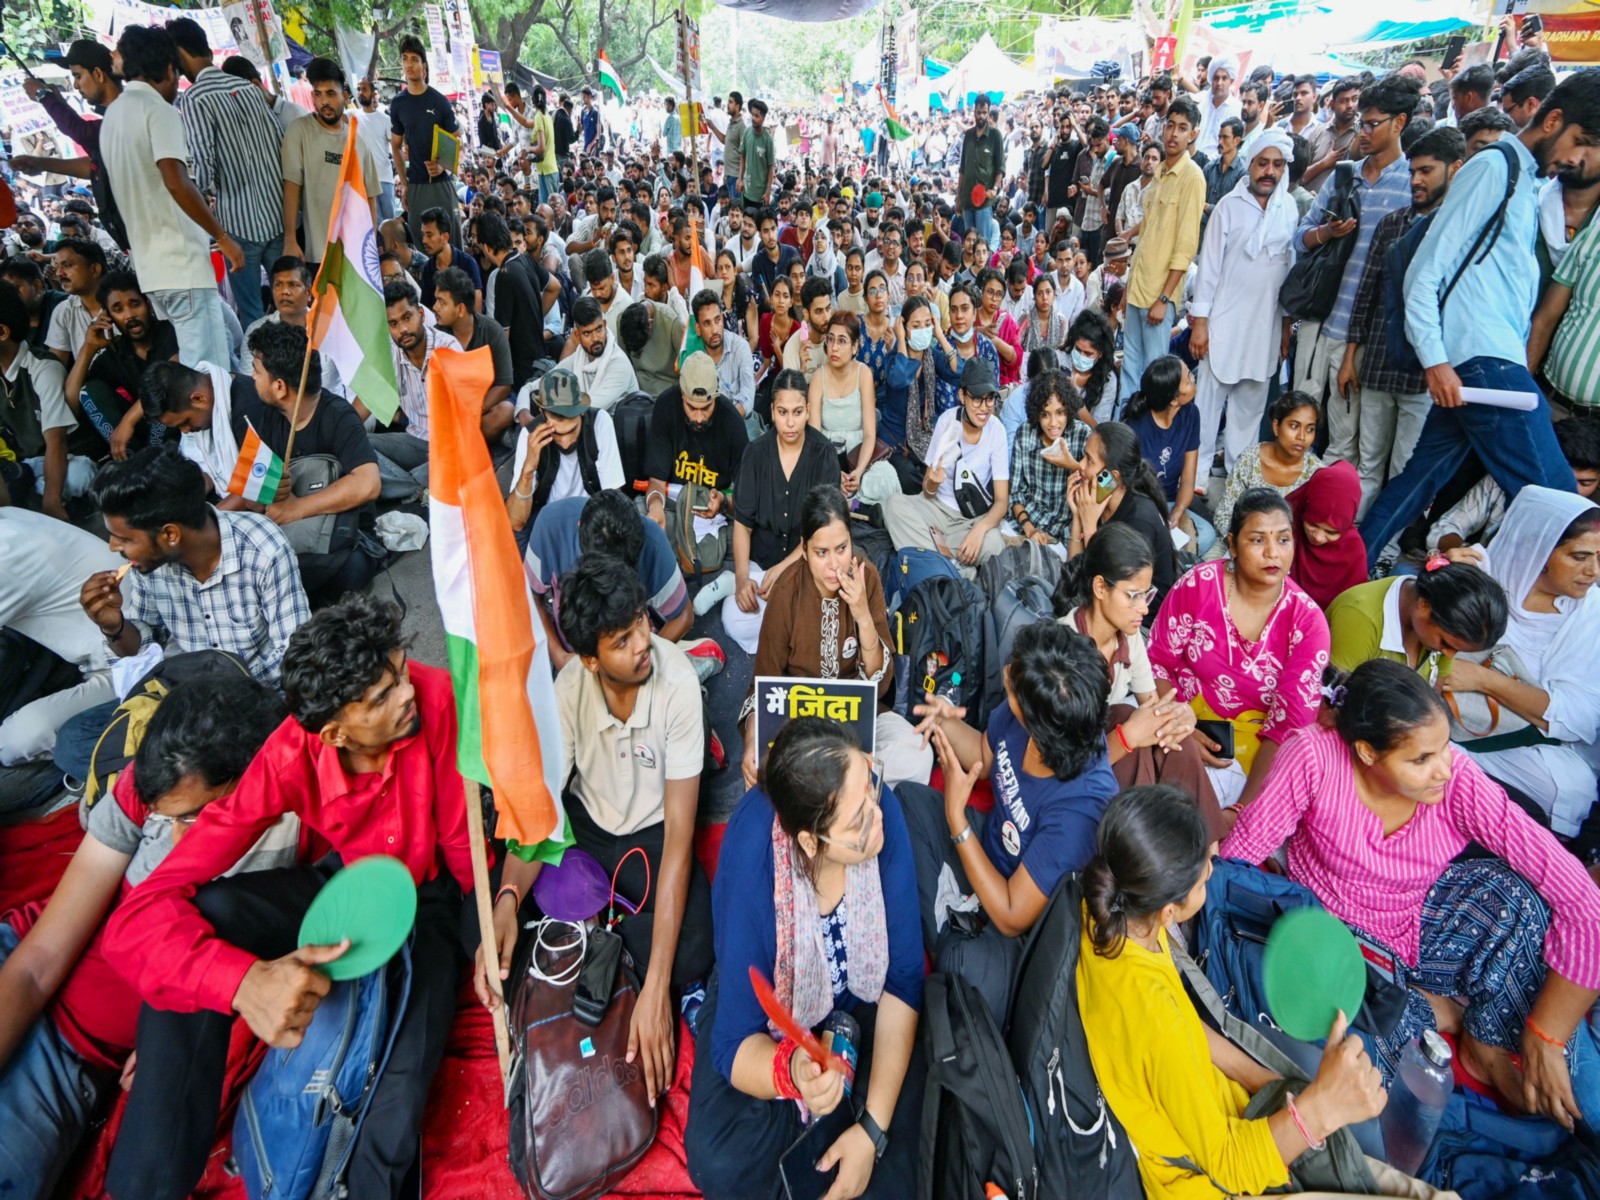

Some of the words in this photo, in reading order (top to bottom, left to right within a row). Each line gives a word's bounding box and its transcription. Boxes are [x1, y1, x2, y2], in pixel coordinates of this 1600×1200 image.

[245, 1, 268, 12] SCAP
[249, 11, 272, 24] NA!
[1541, 30, 1591, 42] RADHAN'S
[84, 399, 114, 440] FAS
[765, 687, 788, 715] मैं
[788, 685, 862, 723] जिंदा
